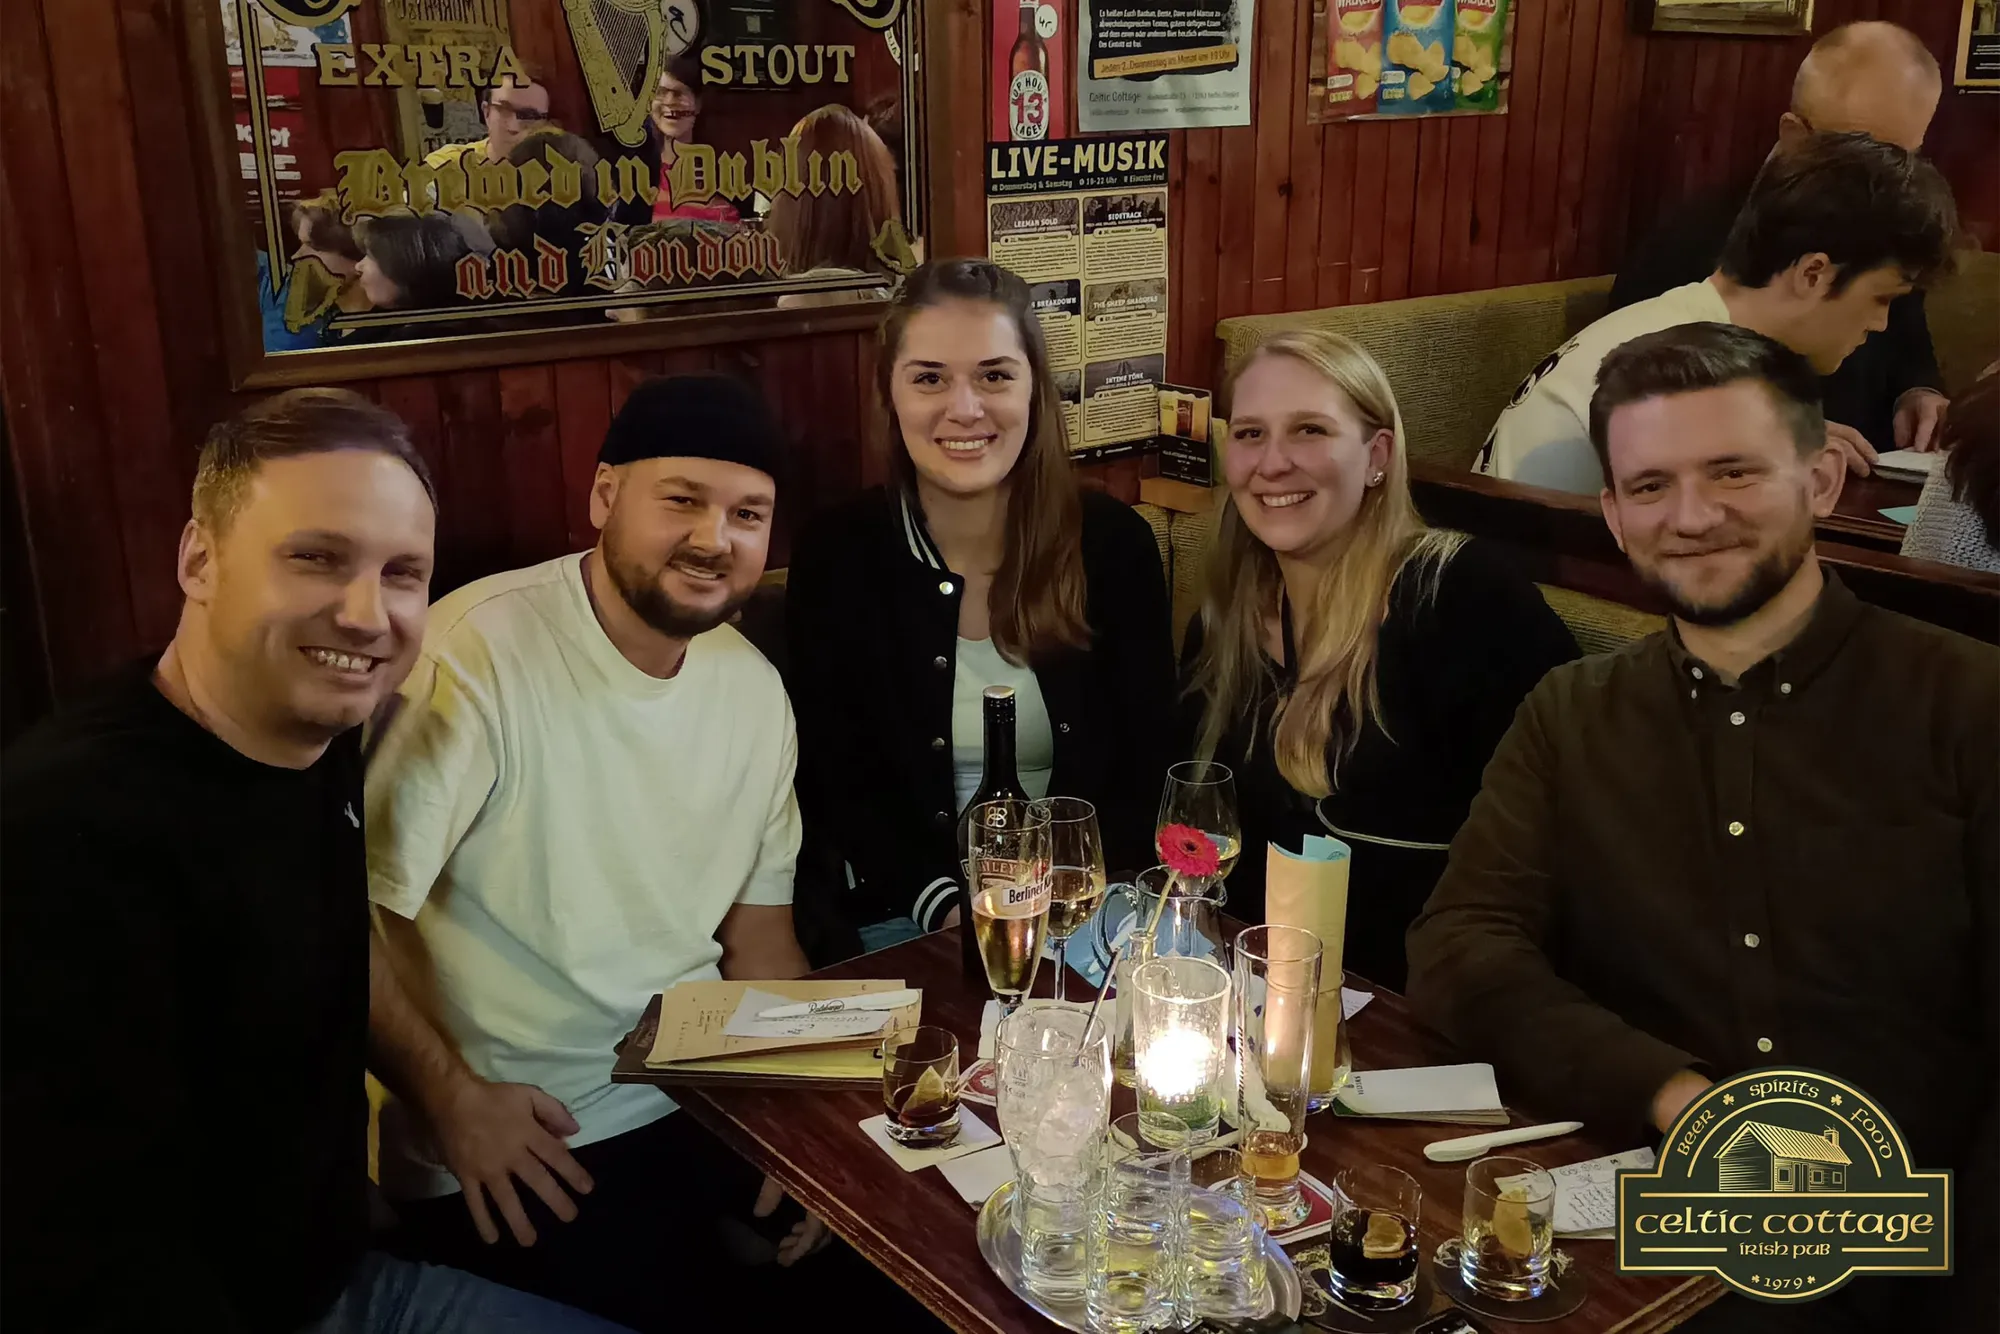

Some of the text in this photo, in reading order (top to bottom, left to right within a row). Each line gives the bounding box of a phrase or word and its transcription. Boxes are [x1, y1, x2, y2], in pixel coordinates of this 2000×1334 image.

[314, 43, 531, 88] EXTRA
[701, 44, 855, 85] STOUT
[1012, 93, 1044, 124] 13
[991, 139, 1167, 179] LIVE-MUSIK
[335, 136, 863, 225] Brewed in Dublin
[455, 221, 788, 299] and London
[1009, 882, 1043, 904] Berliner
